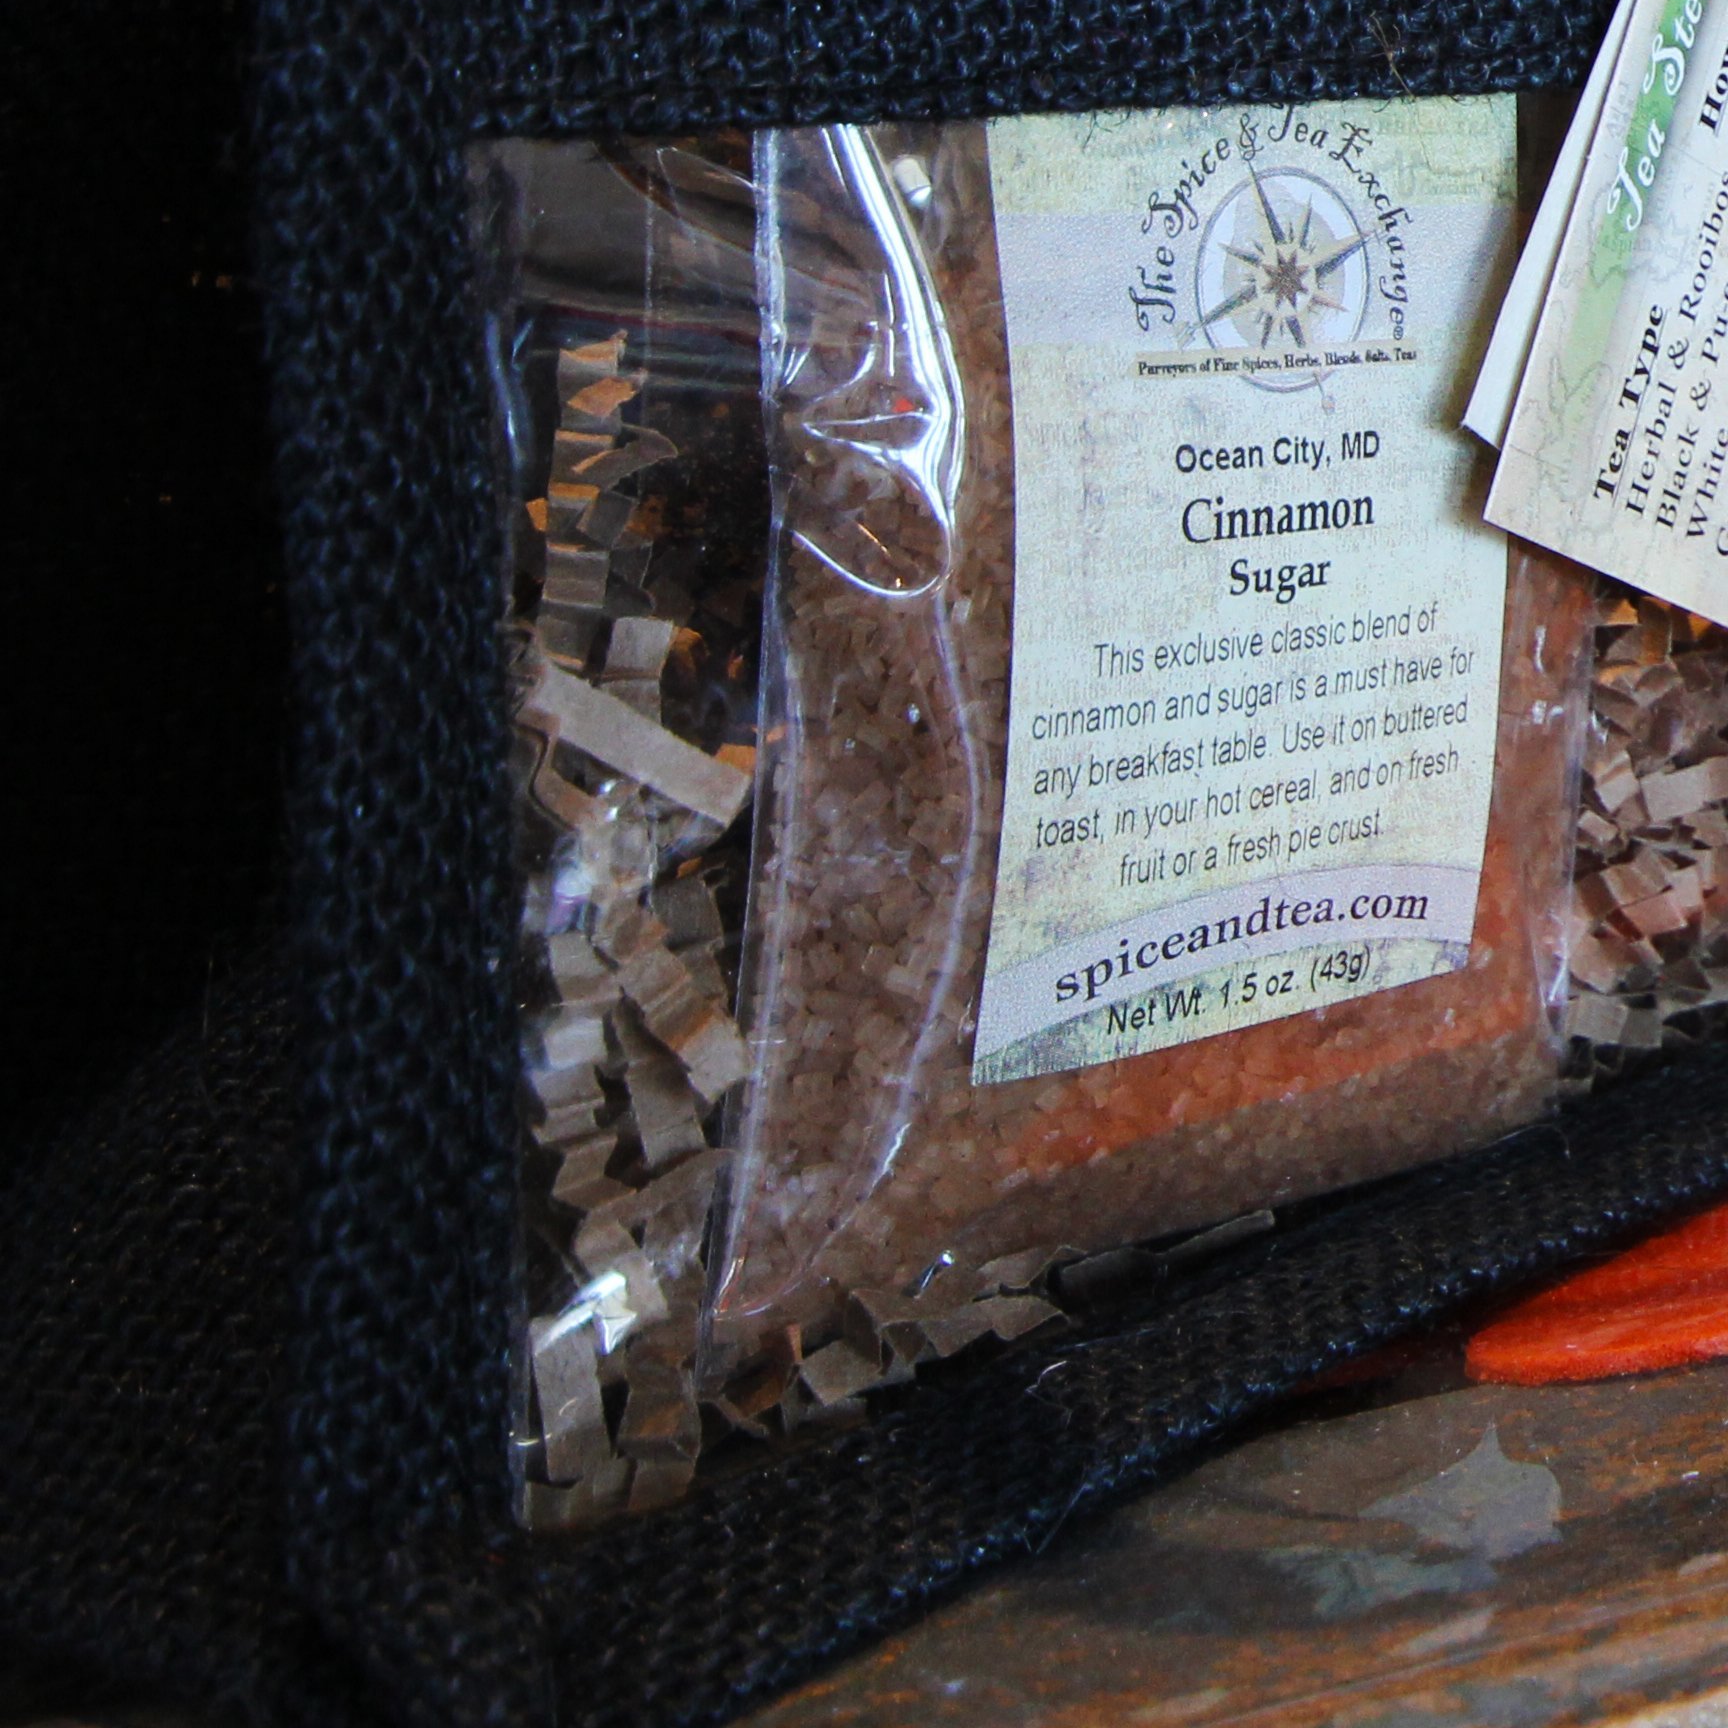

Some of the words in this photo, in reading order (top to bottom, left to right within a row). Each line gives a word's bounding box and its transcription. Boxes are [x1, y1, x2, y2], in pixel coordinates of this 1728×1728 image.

[1238, 113, 1264, 161] &
[1267, 103, 1329, 150] Tea
[1141, 136, 1231, 239] Spice
[1607, 119, 1666, 232] Tea
[1129, 245, 1176, 331] The
[1594, 425, 1631, 501] Tea
[1618, 304, 1664, 411] Type
[1626, 384, 1678, 519] Herbal
[1668, 338, 1689, 370] &
[1175, 441, 1264, 473] Ocean
[1272, 435, 1332, 471] City,
[1341, 430, 1381, 460] MD
[1655, 426, 1699, 530] Black
[1690, 378, 1711, 411] &
[1181, 494, 1375, 544] Cinnamon
[1229, 557, 1332, 604] Sugar
[1094, 640, 1144, 679] This
[1154, 629, 1264, 672] exclusive
[1270, 618, 1346, 655] classic
[1352, 606, 1411, 643] blend
[1416, 600, 1438, 633] of
[1032, 698, 1156, 741] cinnamon
[1164, 684, 1211, 721] and
[1217, 678, 1283, 718] sugar
[1289, 673, 1307, 703] is
[1313, 674, 1328, 699] a
[1334, 660, 1388, 696] must
[1394, 652, 1443, 686] have
[1448, 645, 1476, 675] for
[1033, 765, 1082, 801] any
[1087, 736, 1205, 788] breakfast
[1211, 723, 1274, 766] table.
[1280, 722, 1325, 755] Use
[1331, 716, 1347, 747] it
[1350, 713, 1377, 742] on
[1383, 694, 1470, 738] buttered
[1035, 809, 1104, 850] toast,
[1113, 806, 1136, 837] in
[1143, 793, 1199, 839] your
[1205, 786, 1242, 820] hot
[1248, 771, 1322, 811] cereal,
[1329, 760, 1371, 794] and
[1375, 758, 1402, 786] on
[1407, 744, 1460, 782] fresh
[1118, 852, 1166, 889] fruit
[1172, 847, 1199, 877] or
[1203, 845, 1218, 872] a
[1226, 828, 1281, 866] fresh
[1287, 822, 1322, 862] pie
[1327, 806, 1386, 847] crust.
[1054, 891, 1430, 1005] spiceandtea.com
[1106, 1000, 1156, 1037] Net
[1164, 987, 1208, 1023] Wt.
[1219, 974, 1258, 1011] 1.5
[1265, 971, 1302, 999] oz.
[1309, 945, 1373, 993] (43g)
